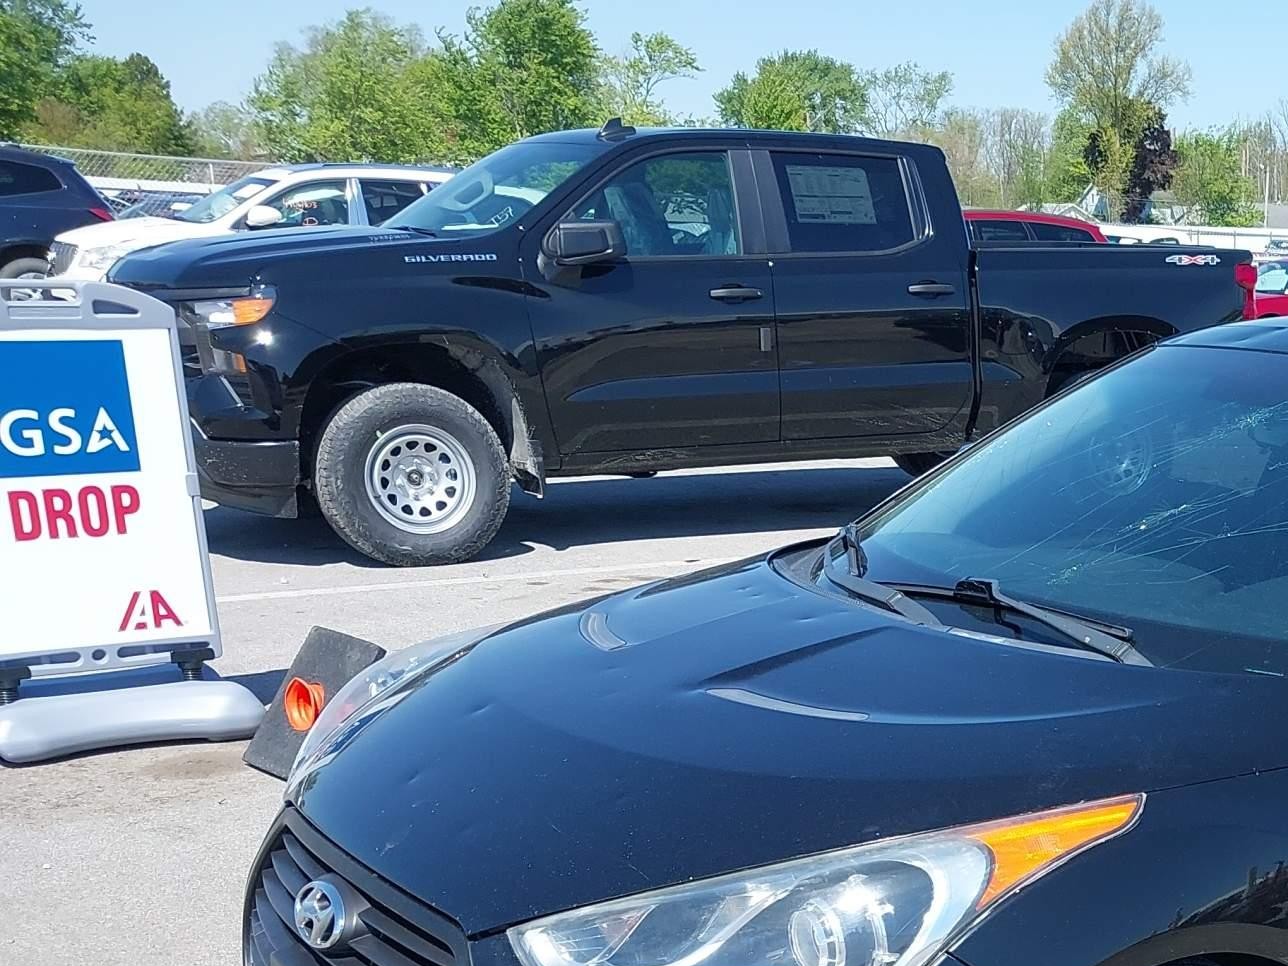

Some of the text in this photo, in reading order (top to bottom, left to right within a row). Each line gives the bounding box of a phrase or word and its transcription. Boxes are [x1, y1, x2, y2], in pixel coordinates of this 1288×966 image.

[404, 253, 497, 263] SILVERADO
[0, 406, 130, 457] GSA
[8, 485, 141, 541] DROP
